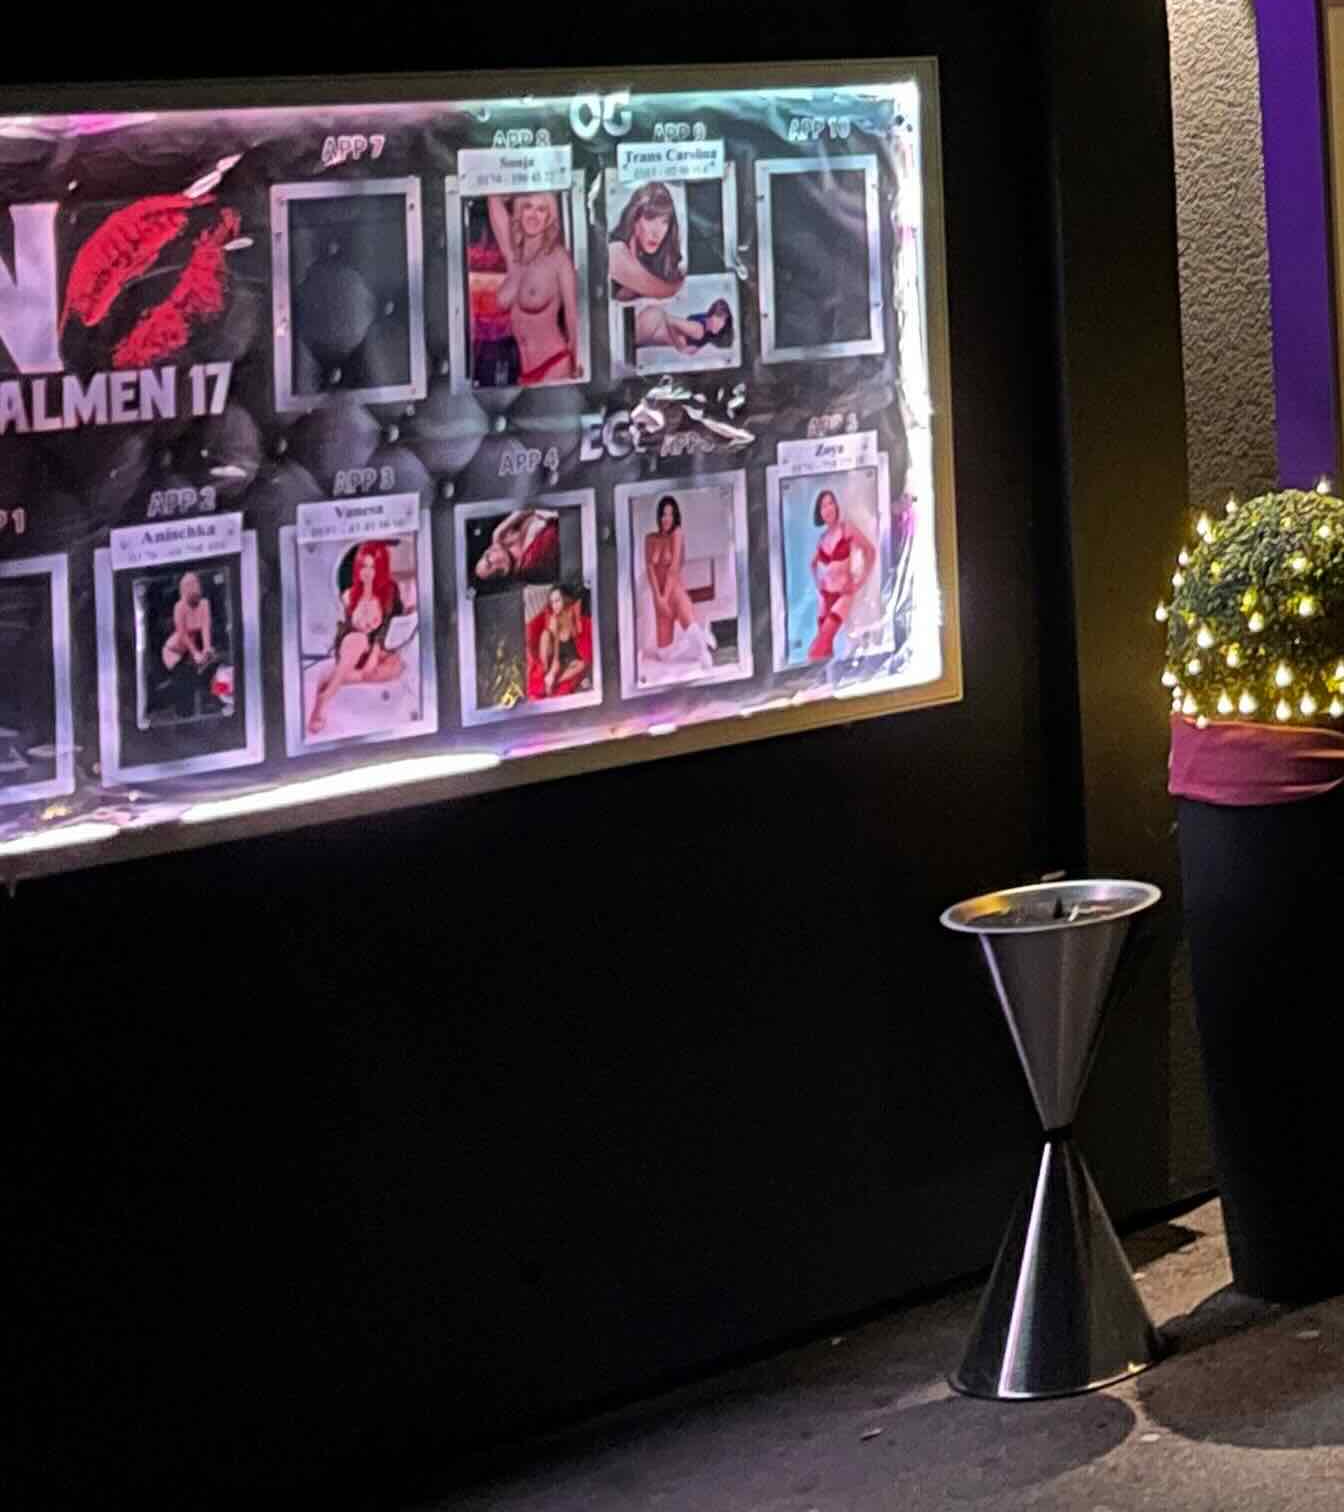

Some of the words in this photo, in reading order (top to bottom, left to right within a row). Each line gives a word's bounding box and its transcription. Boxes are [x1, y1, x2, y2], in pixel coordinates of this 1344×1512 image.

[321, 135, 368, 162] APP
[369, 133, 386, 159] 7
[491, 129, 534, 150] APP
[189, 361, 233, 416] 17
[498, 448, 542, 477] APP
[543, 447, 559, 471] 4
[332, 467, 379, 497] APP
[146, 487, 198, 518] APP
[199, 485, 216, 511] 2
